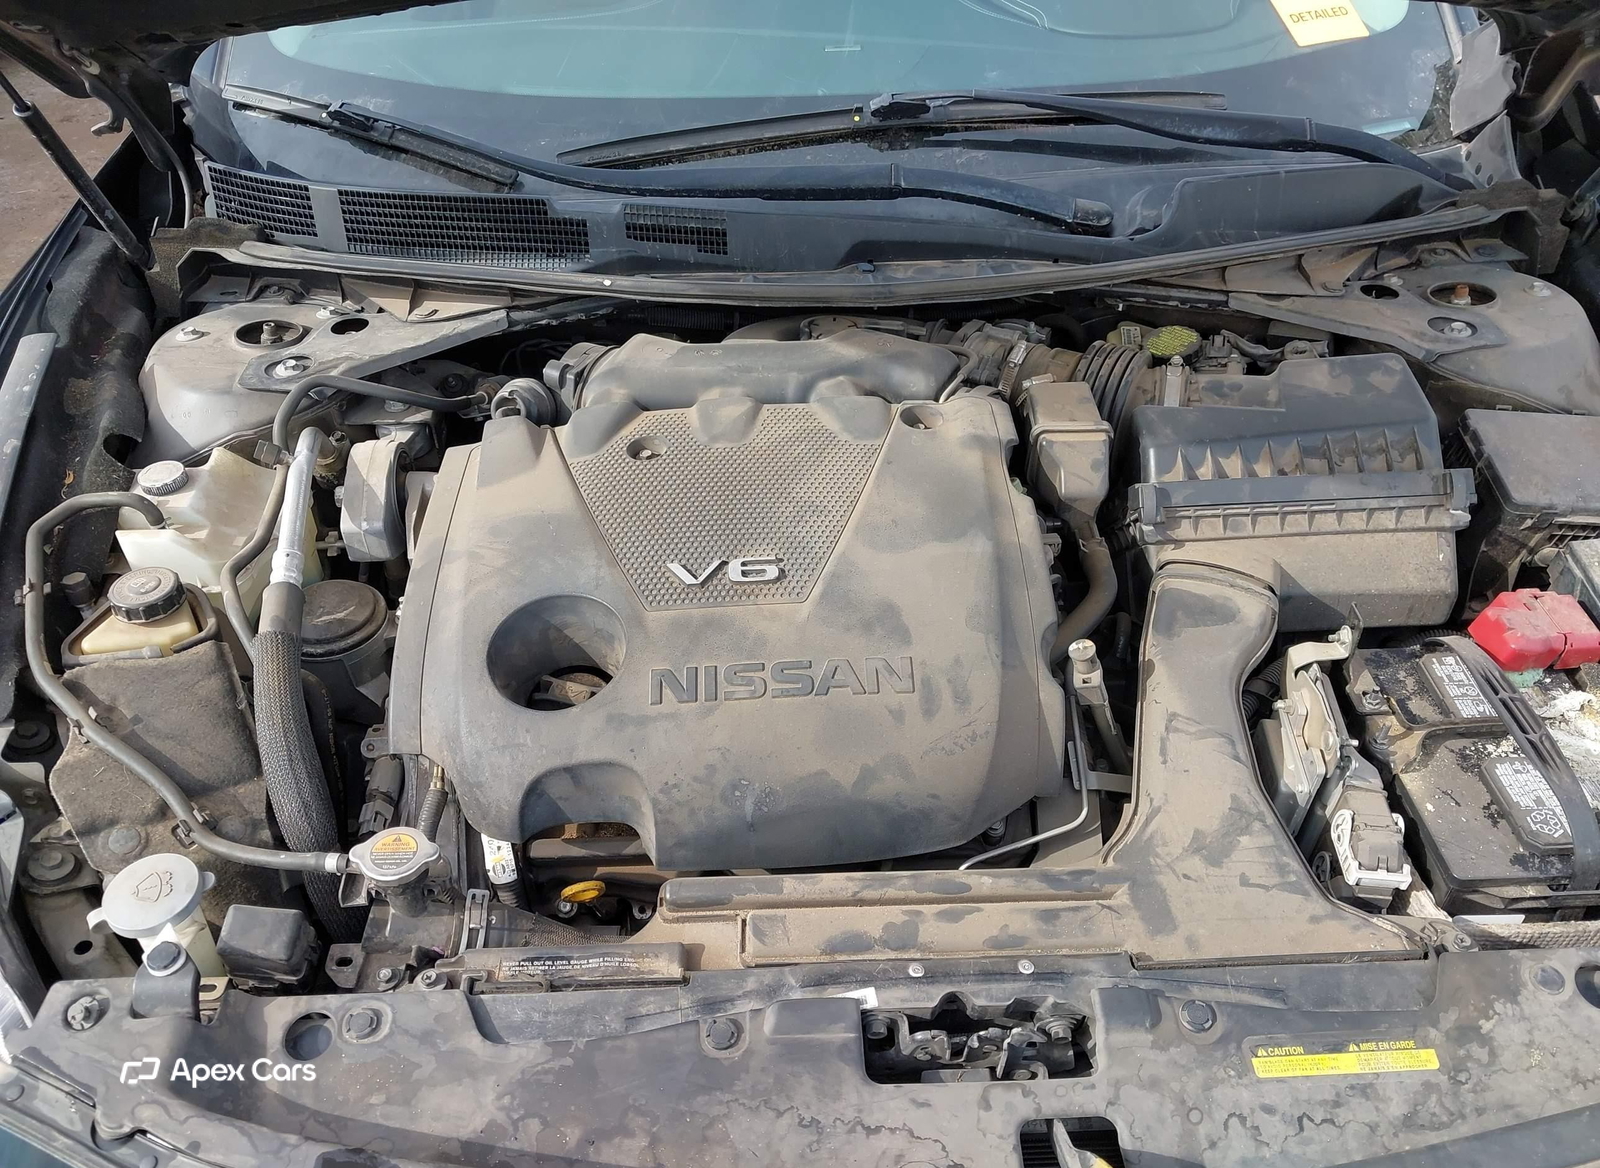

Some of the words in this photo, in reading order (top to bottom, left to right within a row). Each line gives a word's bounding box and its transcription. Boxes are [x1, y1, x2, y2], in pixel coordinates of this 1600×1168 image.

[1289, 6, 1348, 24] DETAILED
[666, 557, 784, 587] V6
[650, 656, 915, 706] NISSAN
[1268, 1046, 1304, 1056] CAUTION
[1360, 1042, 1378, 1051] MISE
[1378, 1042, 1390, 1050] EN
[1390, 1041, 1416, 1049] GARDE
